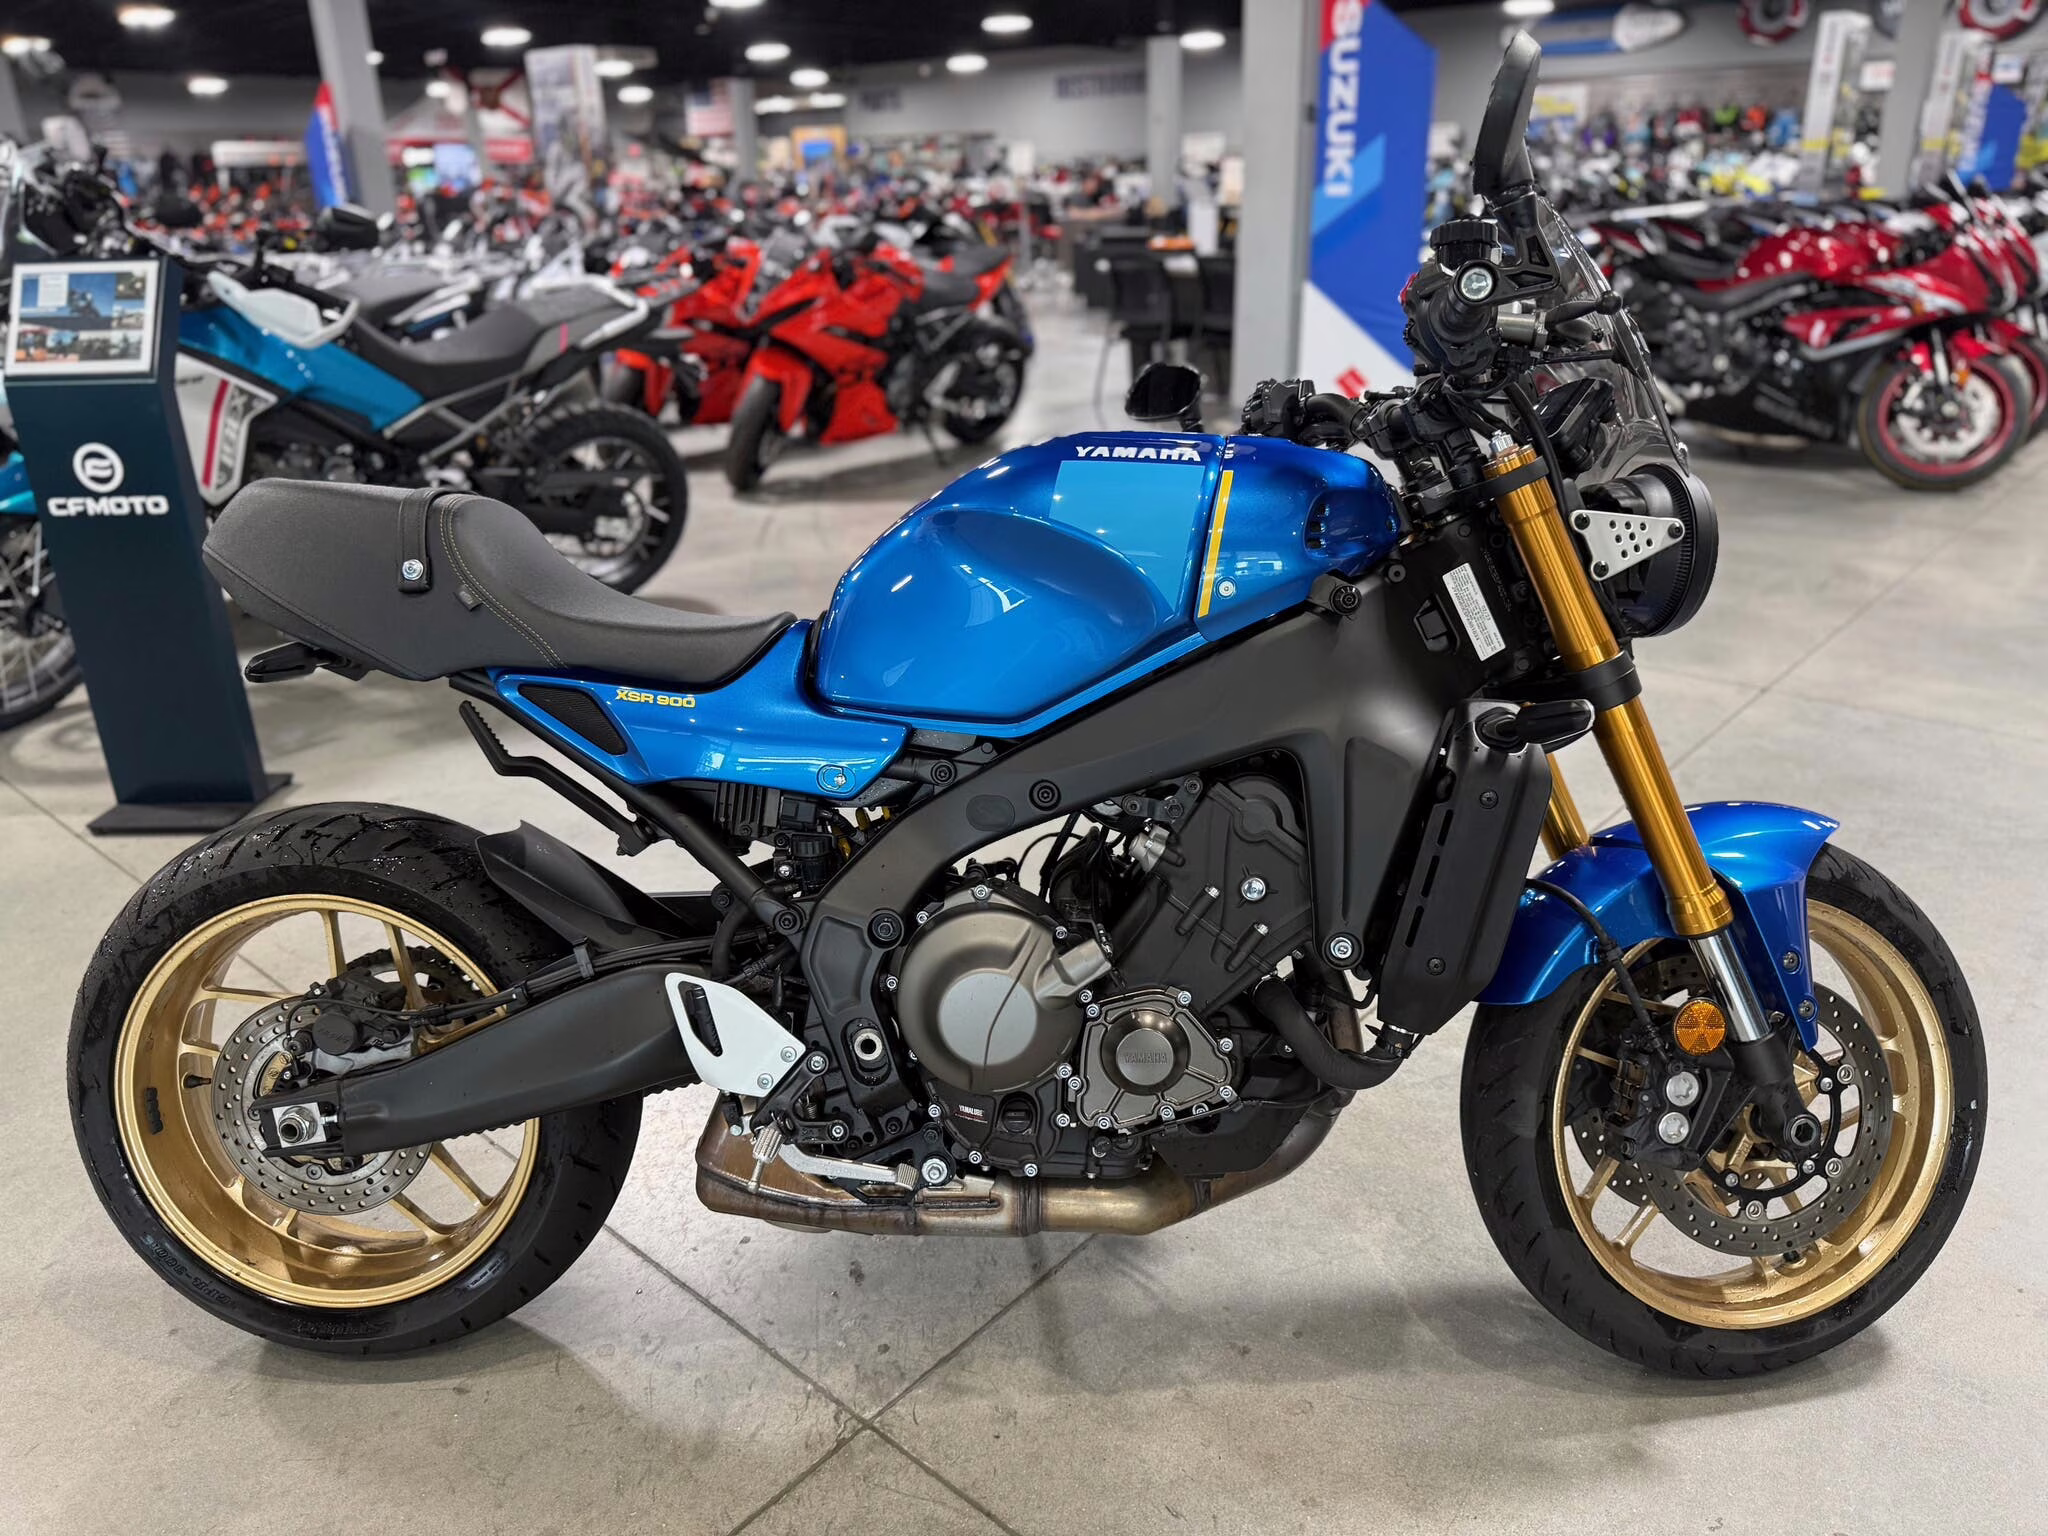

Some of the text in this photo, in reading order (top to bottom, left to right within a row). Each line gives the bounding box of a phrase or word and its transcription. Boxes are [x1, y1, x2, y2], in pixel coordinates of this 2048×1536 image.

[1324, 0, 1362, 196] SUZUKI
[1075, 446, 1201, 462] YAMAHA
[47, 495, 169, 517] CFMOTO
[615, 688, 696, 708] XSR 900
[1123, 1051, 1168, 1065] YAMAHA
